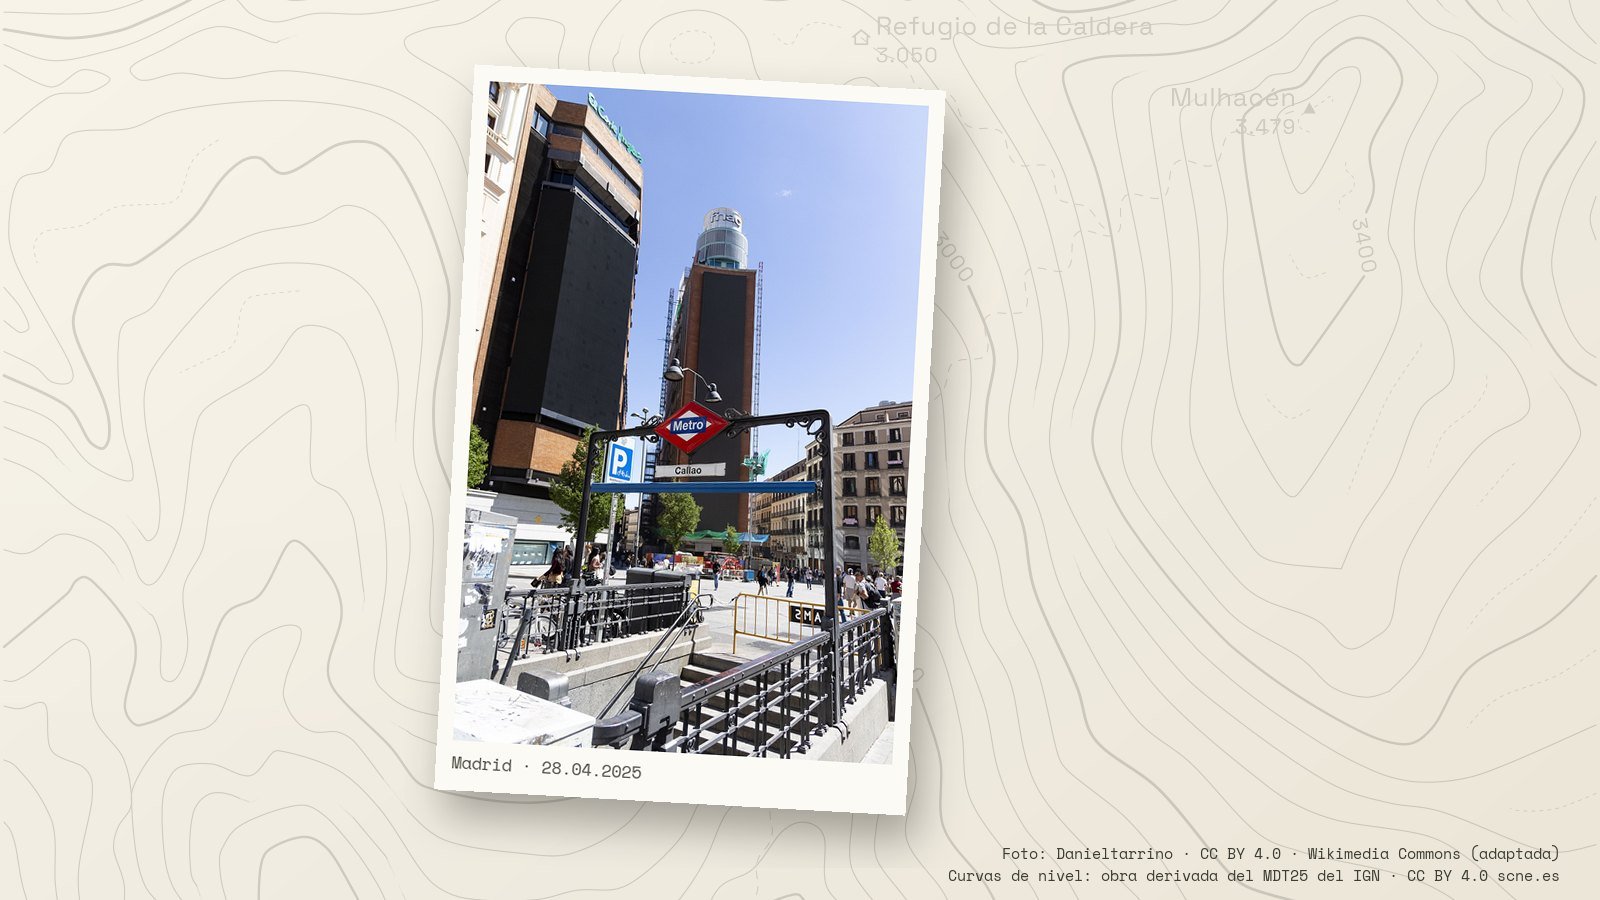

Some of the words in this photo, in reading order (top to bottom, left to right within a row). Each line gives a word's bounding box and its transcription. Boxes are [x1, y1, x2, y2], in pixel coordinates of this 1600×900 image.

[672, 420, 704, 431] Metro
[612, 447, 628, 475] P
[674, 466, 702, 475] Callao
